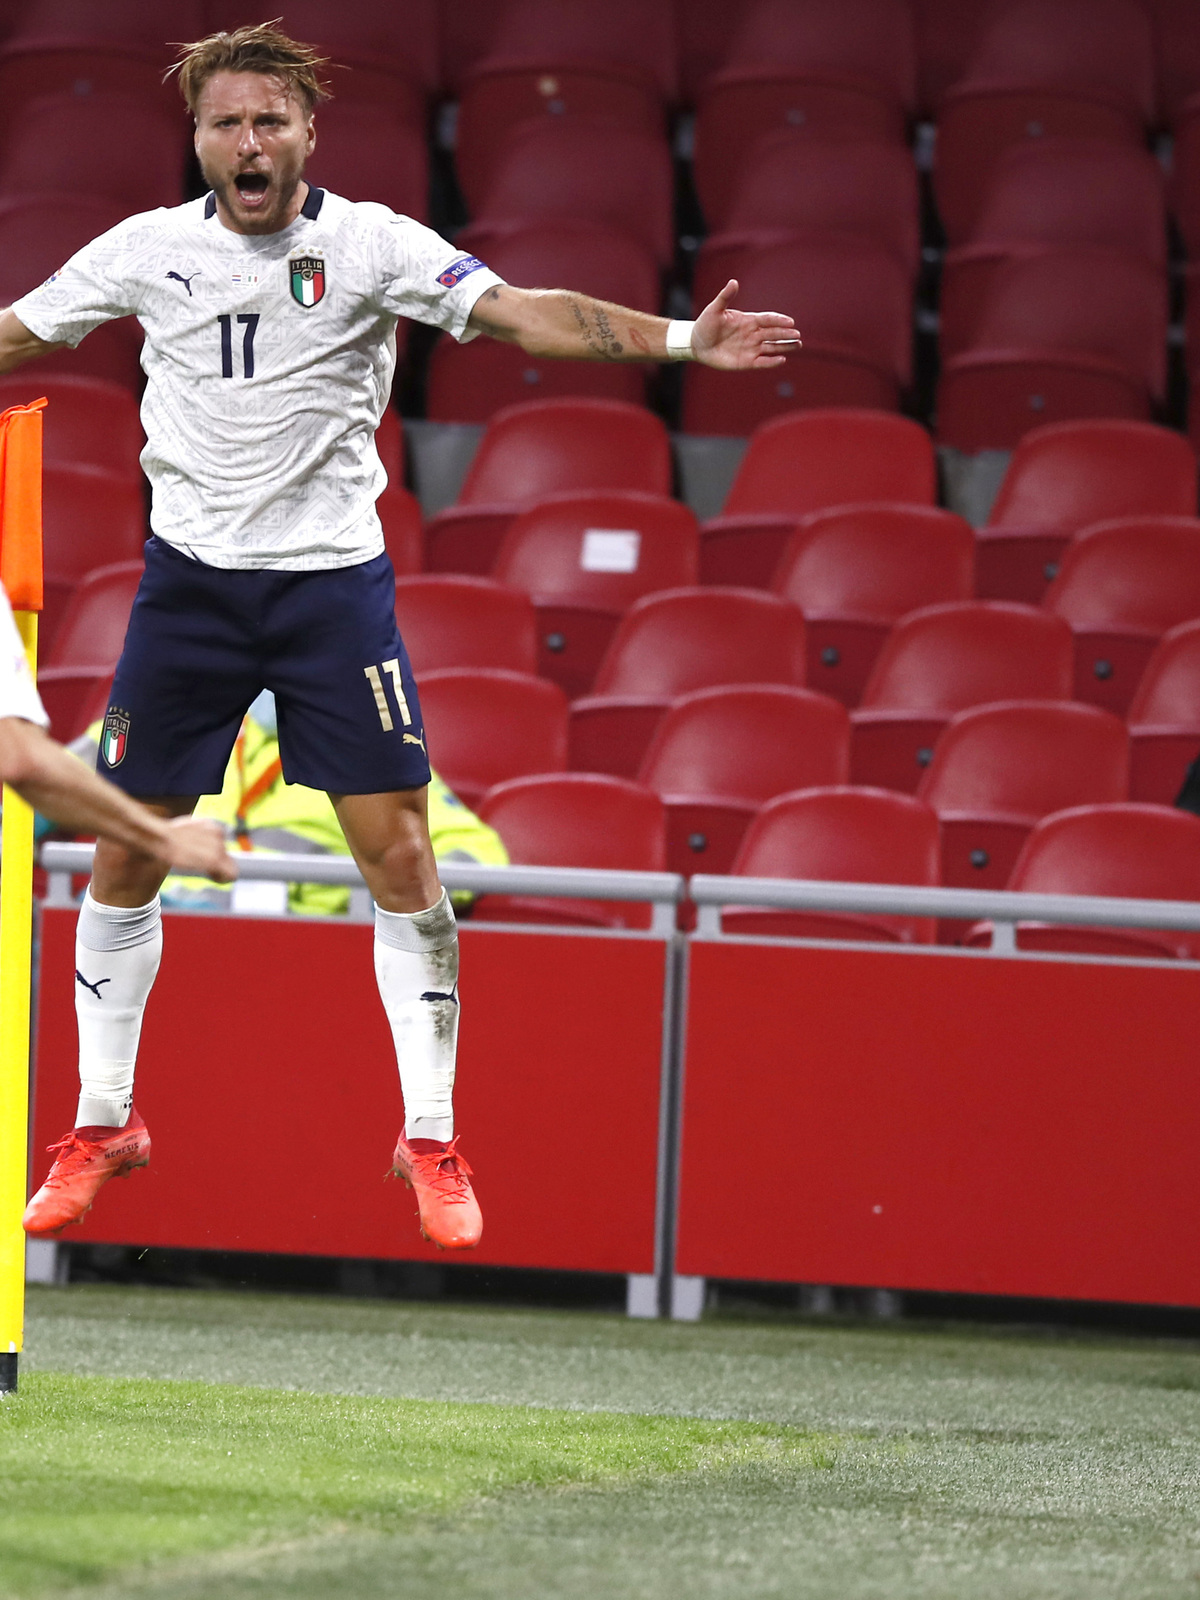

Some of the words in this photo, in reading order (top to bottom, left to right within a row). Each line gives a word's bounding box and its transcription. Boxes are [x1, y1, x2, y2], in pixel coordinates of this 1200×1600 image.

[292, 260, 323, 270] ITALIA
[217, 313, 260, 379] 17
[363, 658, 412, 732] 17
[107, 718, 127, 731] ITALIA
[104, 1142, 139, 1159] NEMESIS
